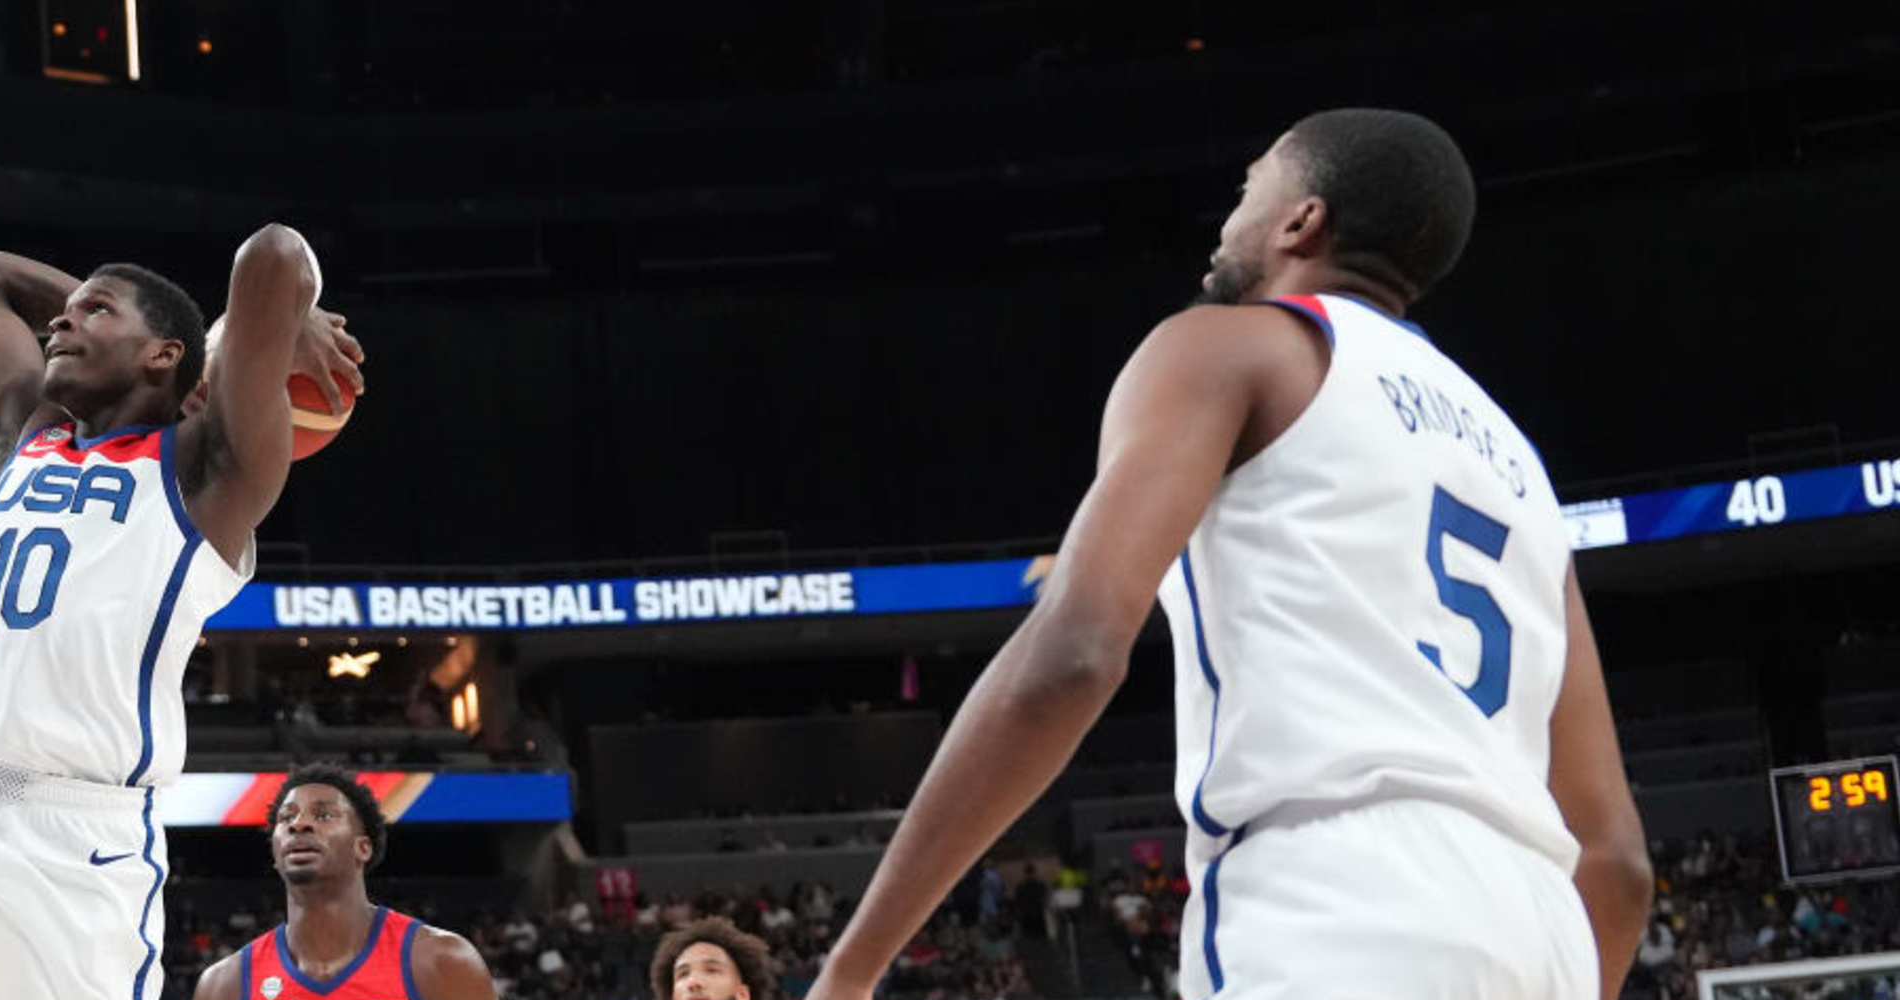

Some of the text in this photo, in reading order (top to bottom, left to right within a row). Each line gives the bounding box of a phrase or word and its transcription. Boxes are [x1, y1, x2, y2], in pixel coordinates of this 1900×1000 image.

[1378, 374, 1527, 499] BRIDGES
[1727, 475, 1787, 527] 40
[275, 572, 855, 627] USA BASKETBALL SHOWCASE
[1415, 484, 1514, 720] 5
